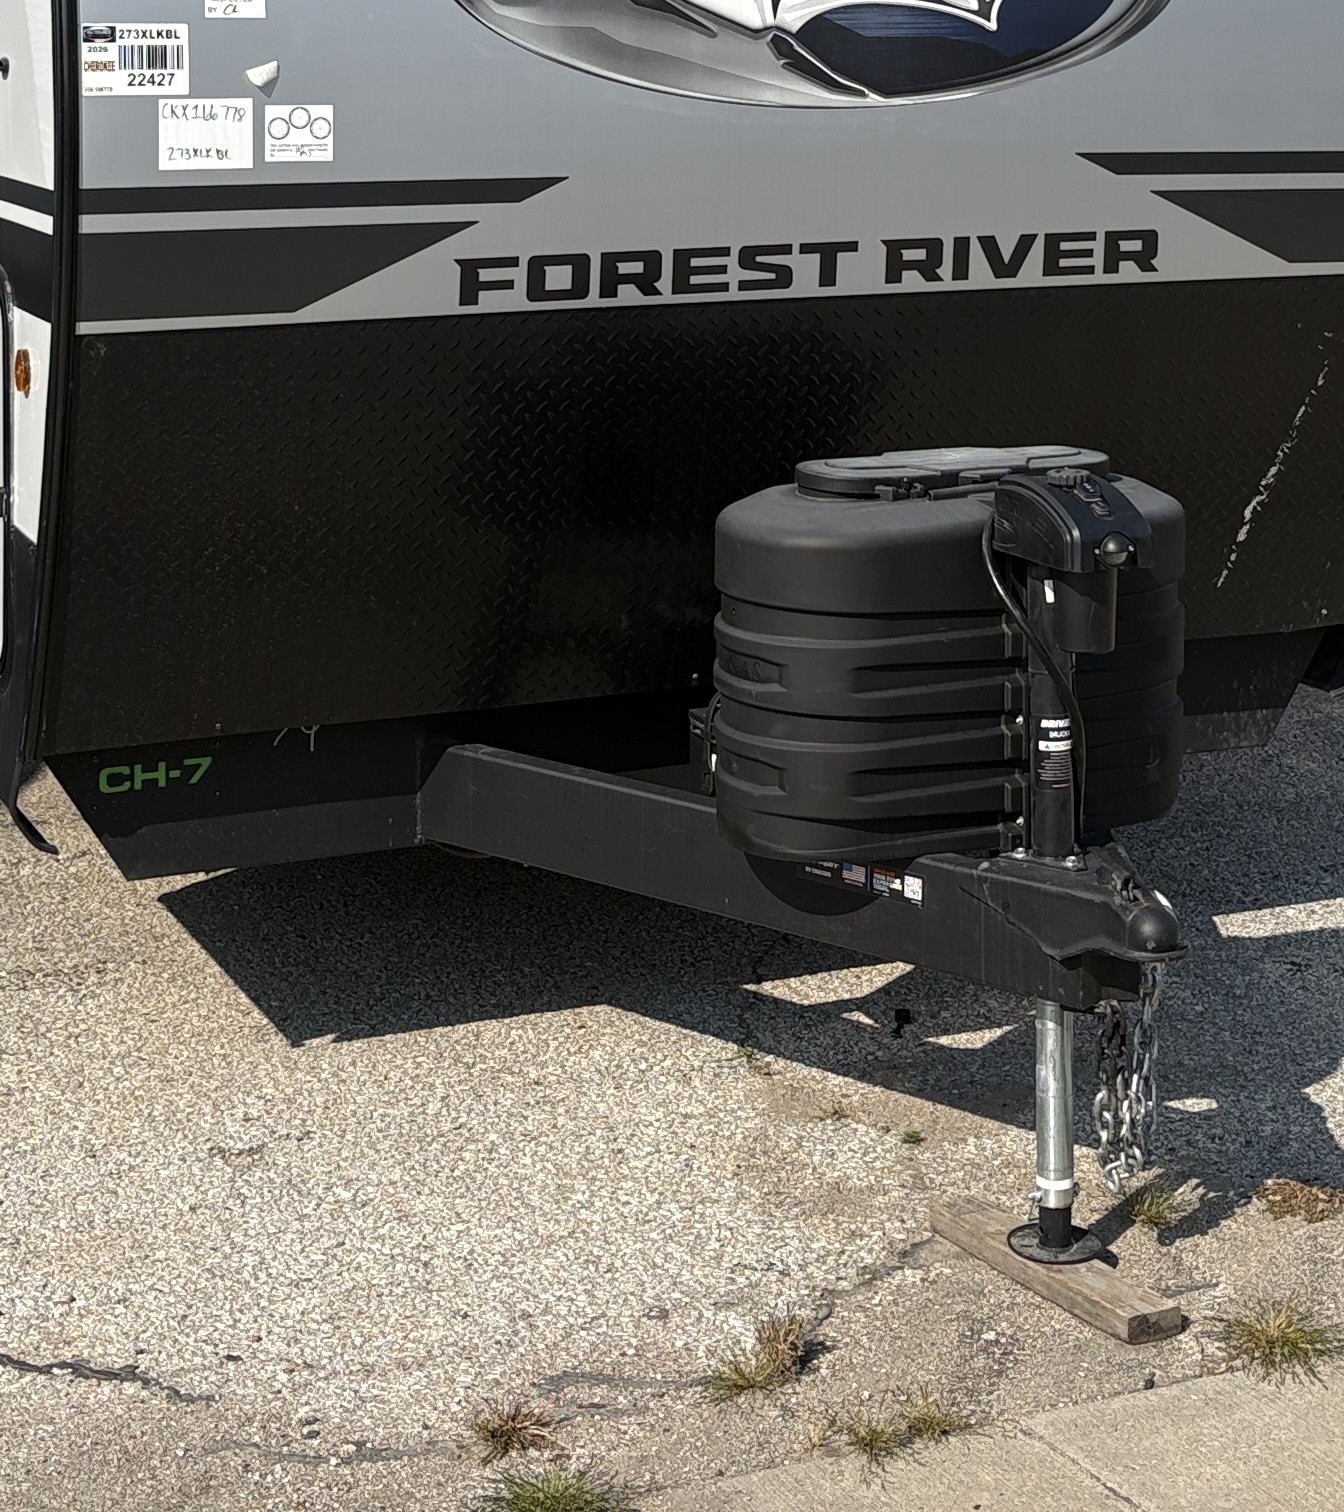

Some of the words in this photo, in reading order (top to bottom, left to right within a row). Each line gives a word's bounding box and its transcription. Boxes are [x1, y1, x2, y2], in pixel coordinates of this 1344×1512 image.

[118, 29, 181, 40] 273XLKBL
[127, 73, 176, 87] 22427
[453, 240, 859, 307] FOREST
[880, 229, 1160, 285] RIVER
[98, 756, 213, 794] CH-7
